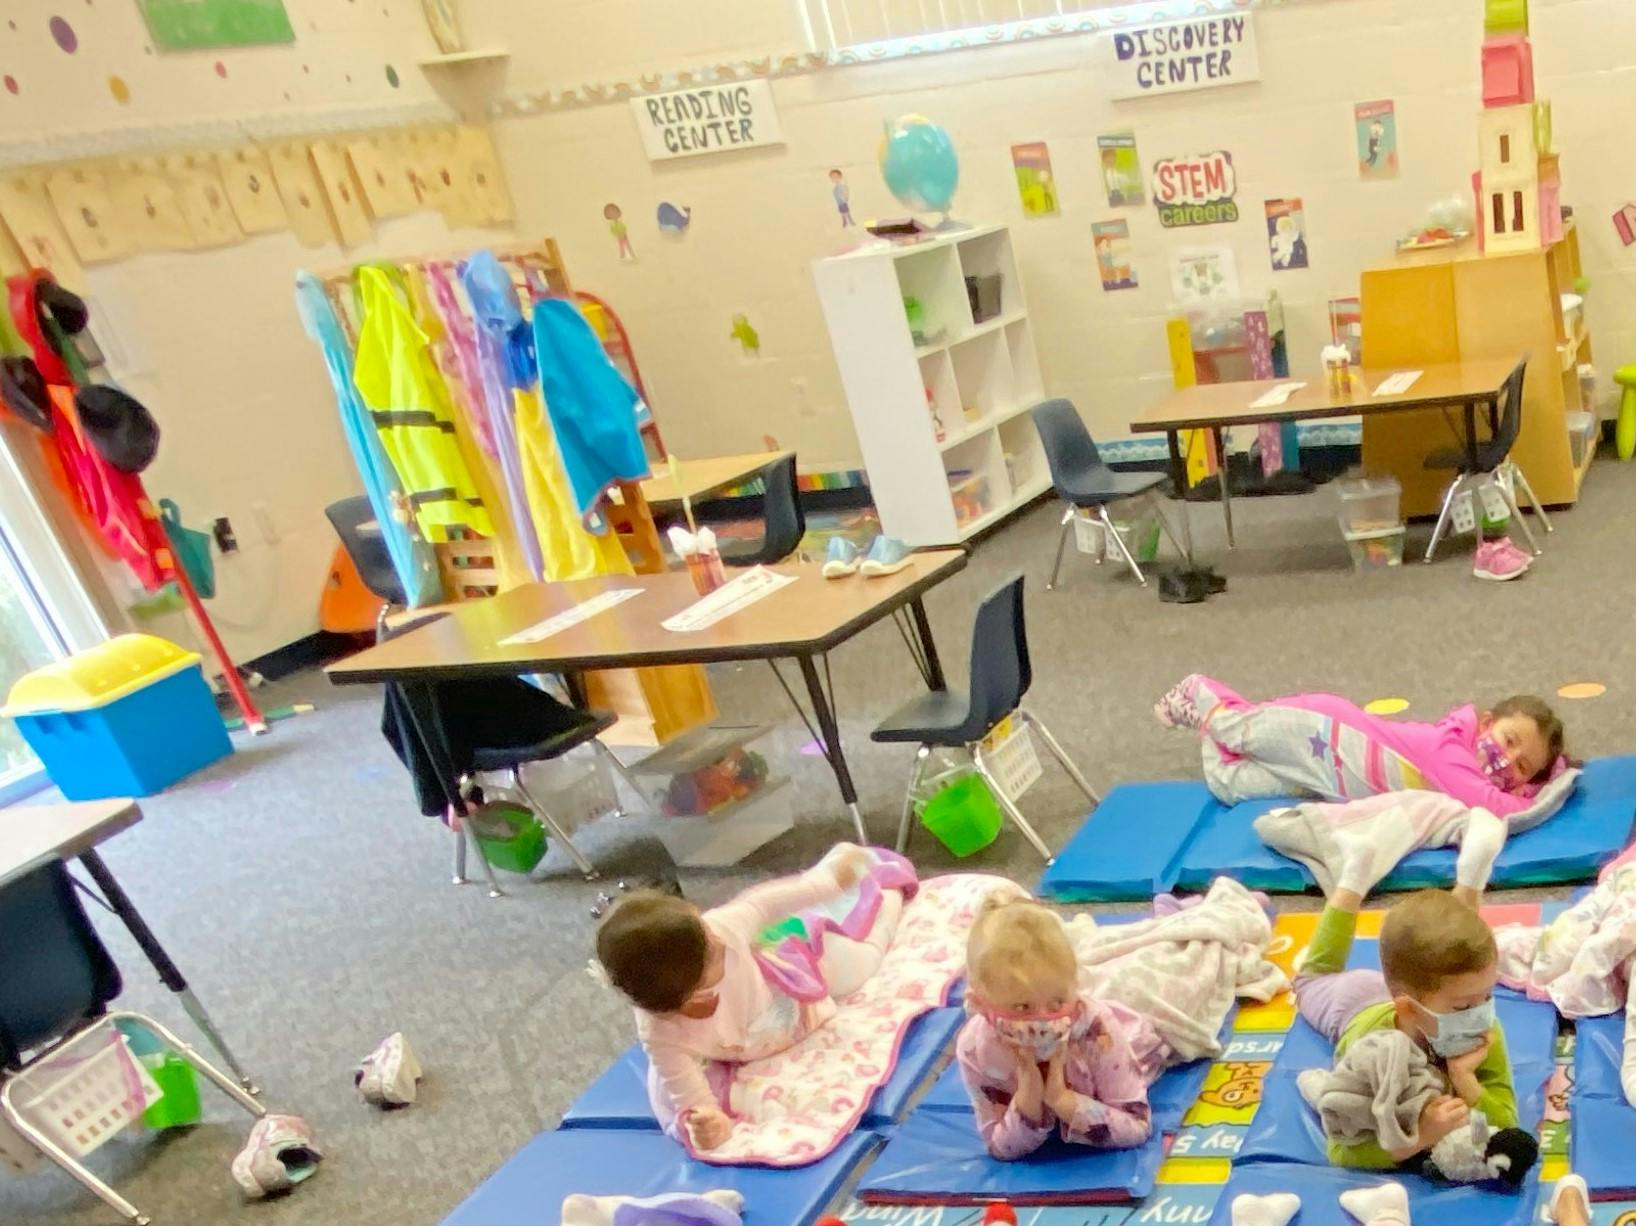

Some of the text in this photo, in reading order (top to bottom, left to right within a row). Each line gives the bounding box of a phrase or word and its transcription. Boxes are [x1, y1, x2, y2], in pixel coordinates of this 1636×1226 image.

[1113, 16, 1245, 61] DISCOVERY
[1137, 50, 1232, 89] CENTER
[646, 86, 753, 127] READING
[663, 118, 754, 153] CENTER
[1158, 158, 1227, 201] STEM
[1160, 202, 1237, 227] careers
[1140, 1196, 1214, 1223] nny
